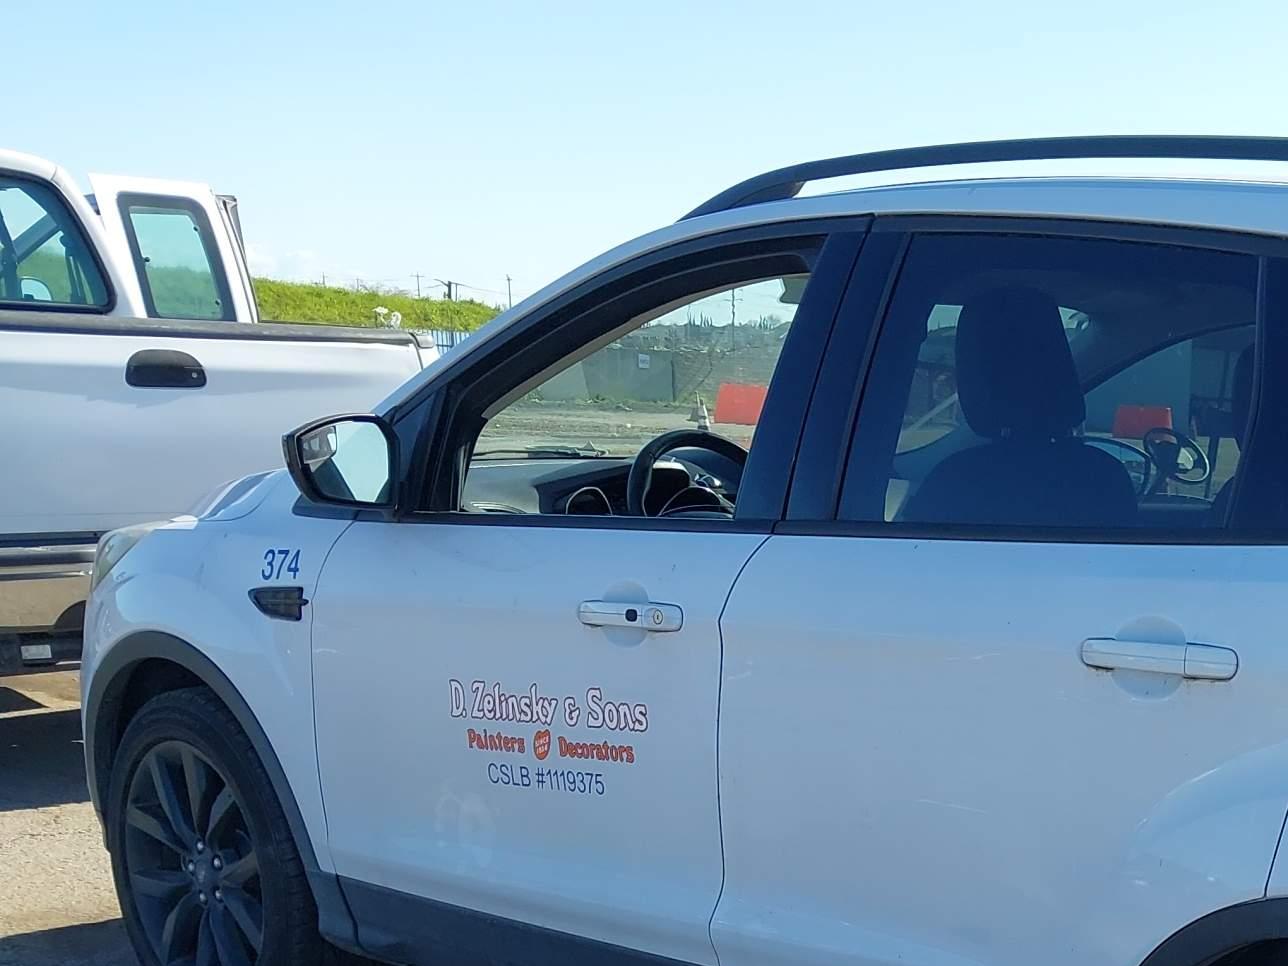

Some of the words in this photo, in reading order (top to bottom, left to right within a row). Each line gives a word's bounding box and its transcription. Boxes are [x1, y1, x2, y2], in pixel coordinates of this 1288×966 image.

[262, 549, 301, 580] 374
[449, 679, 468, 718] D.
[471, 680, 559, 726] Zelinsky
[564, 696, 581, 727] &
[586, 687, 649, 733] Sons
[467, 728, 526, 754] Painters
[557, 736, 635, 764] Decorators
[487, 762, 532, 788] CSLB
[535, 766, 605, 796] #1119375
